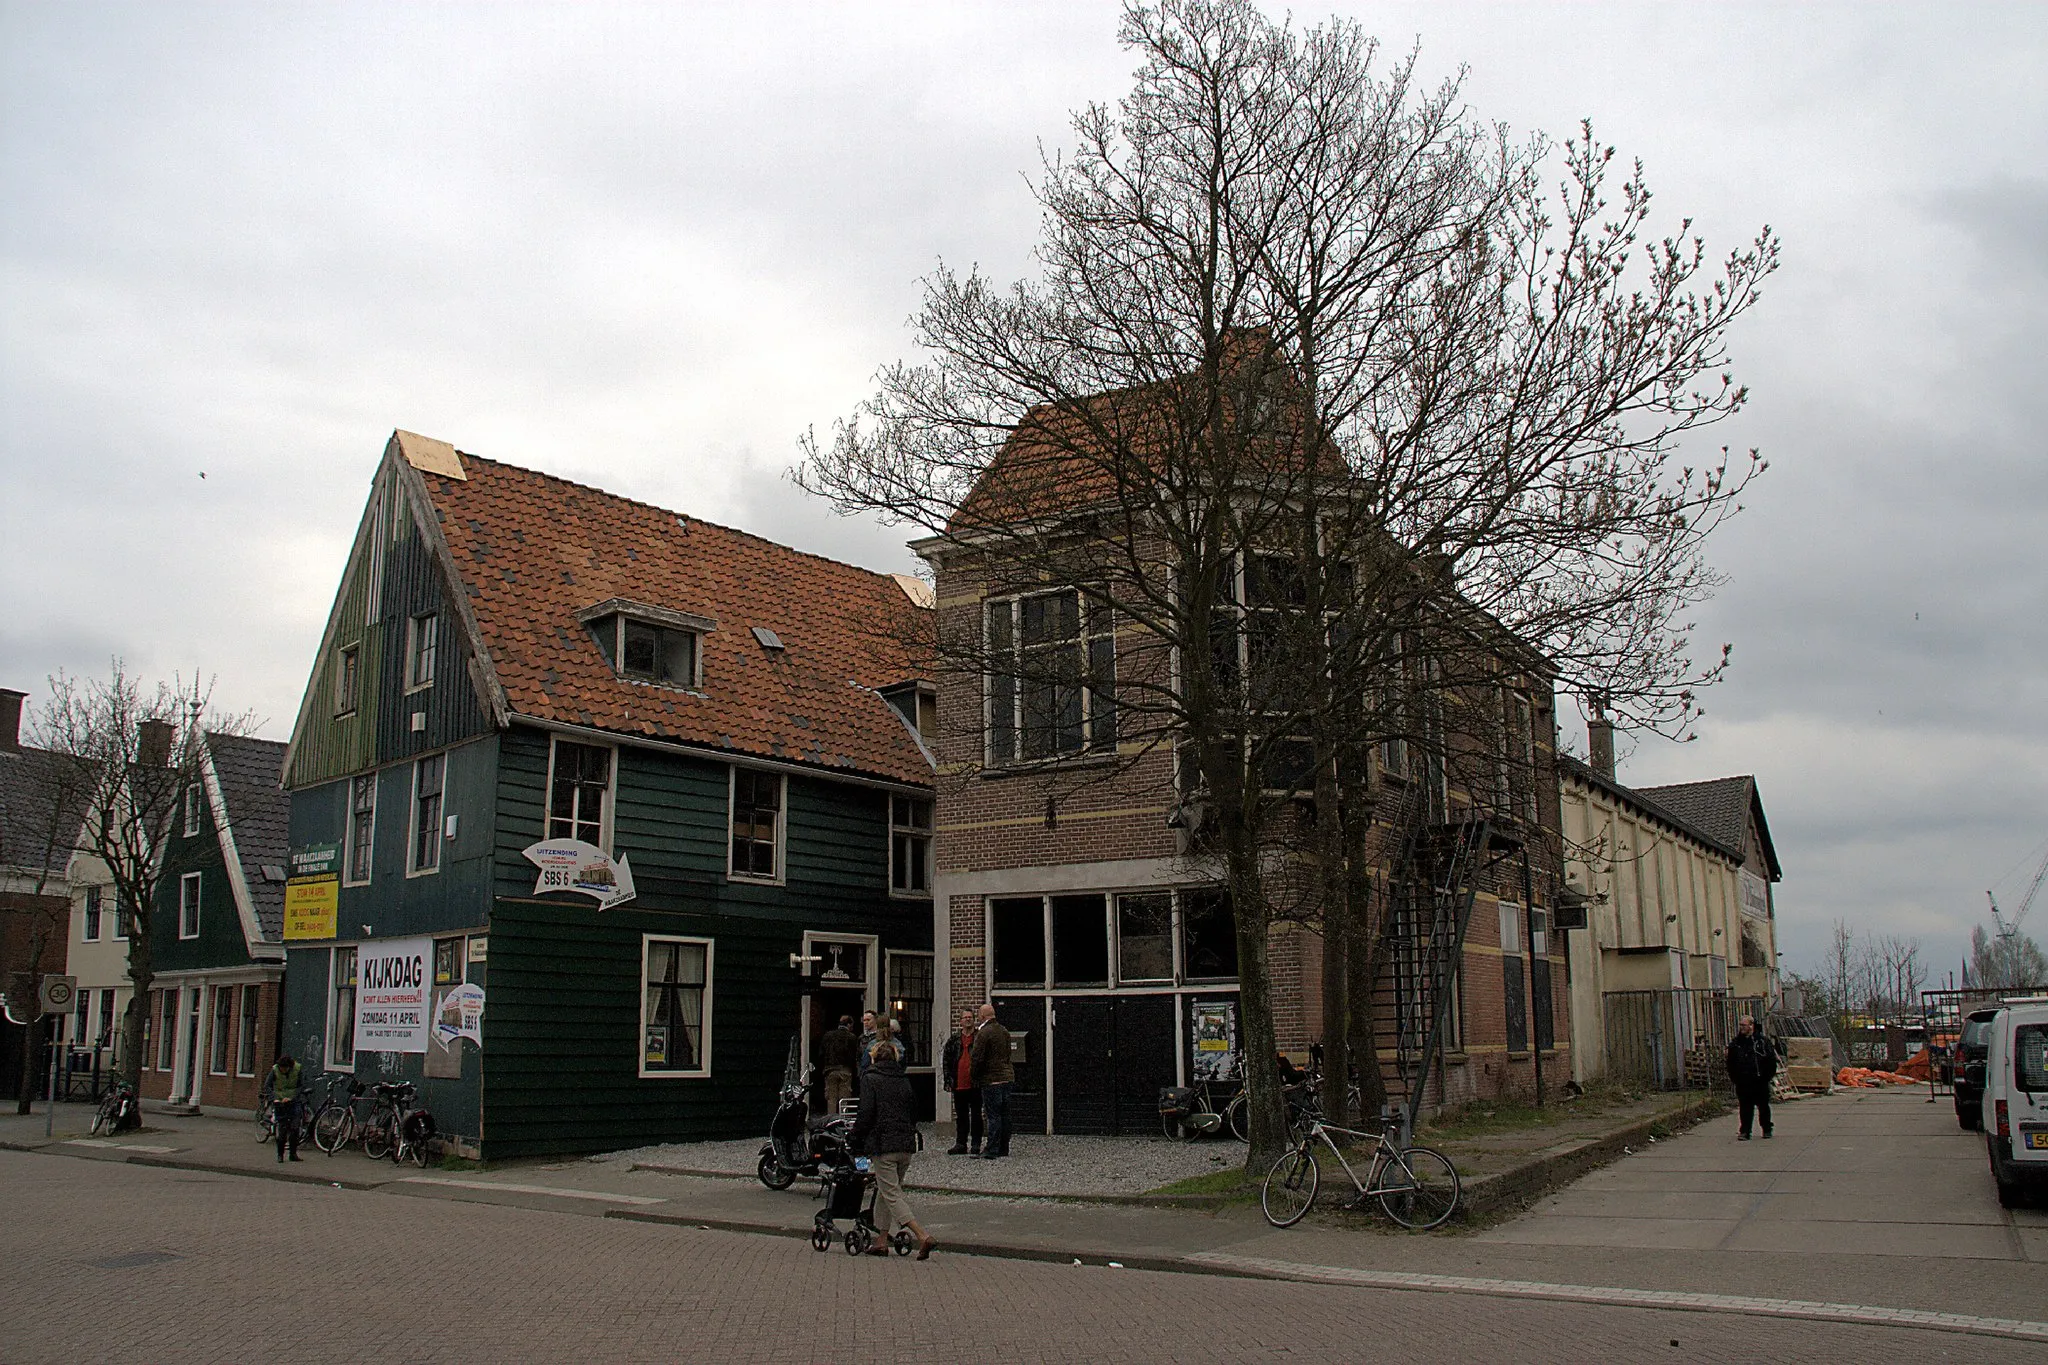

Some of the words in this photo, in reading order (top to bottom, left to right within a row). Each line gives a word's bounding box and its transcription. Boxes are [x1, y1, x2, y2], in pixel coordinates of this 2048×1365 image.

[536, 848, 578, 857] UITZENDING
[544, 871, 561, 885] SBS
[563, 872, 569, 886] 6
[364, 955, 422, 989] KIJKDAG
[53, 989, 67, 998] 30
[377, 995, 390, 1004] ALLEN
[362, 1012, 387, 1024] ZONDAG
[390, 1012, 398, 1024] 11
[399, 1012, 419, 1024] APRIL
